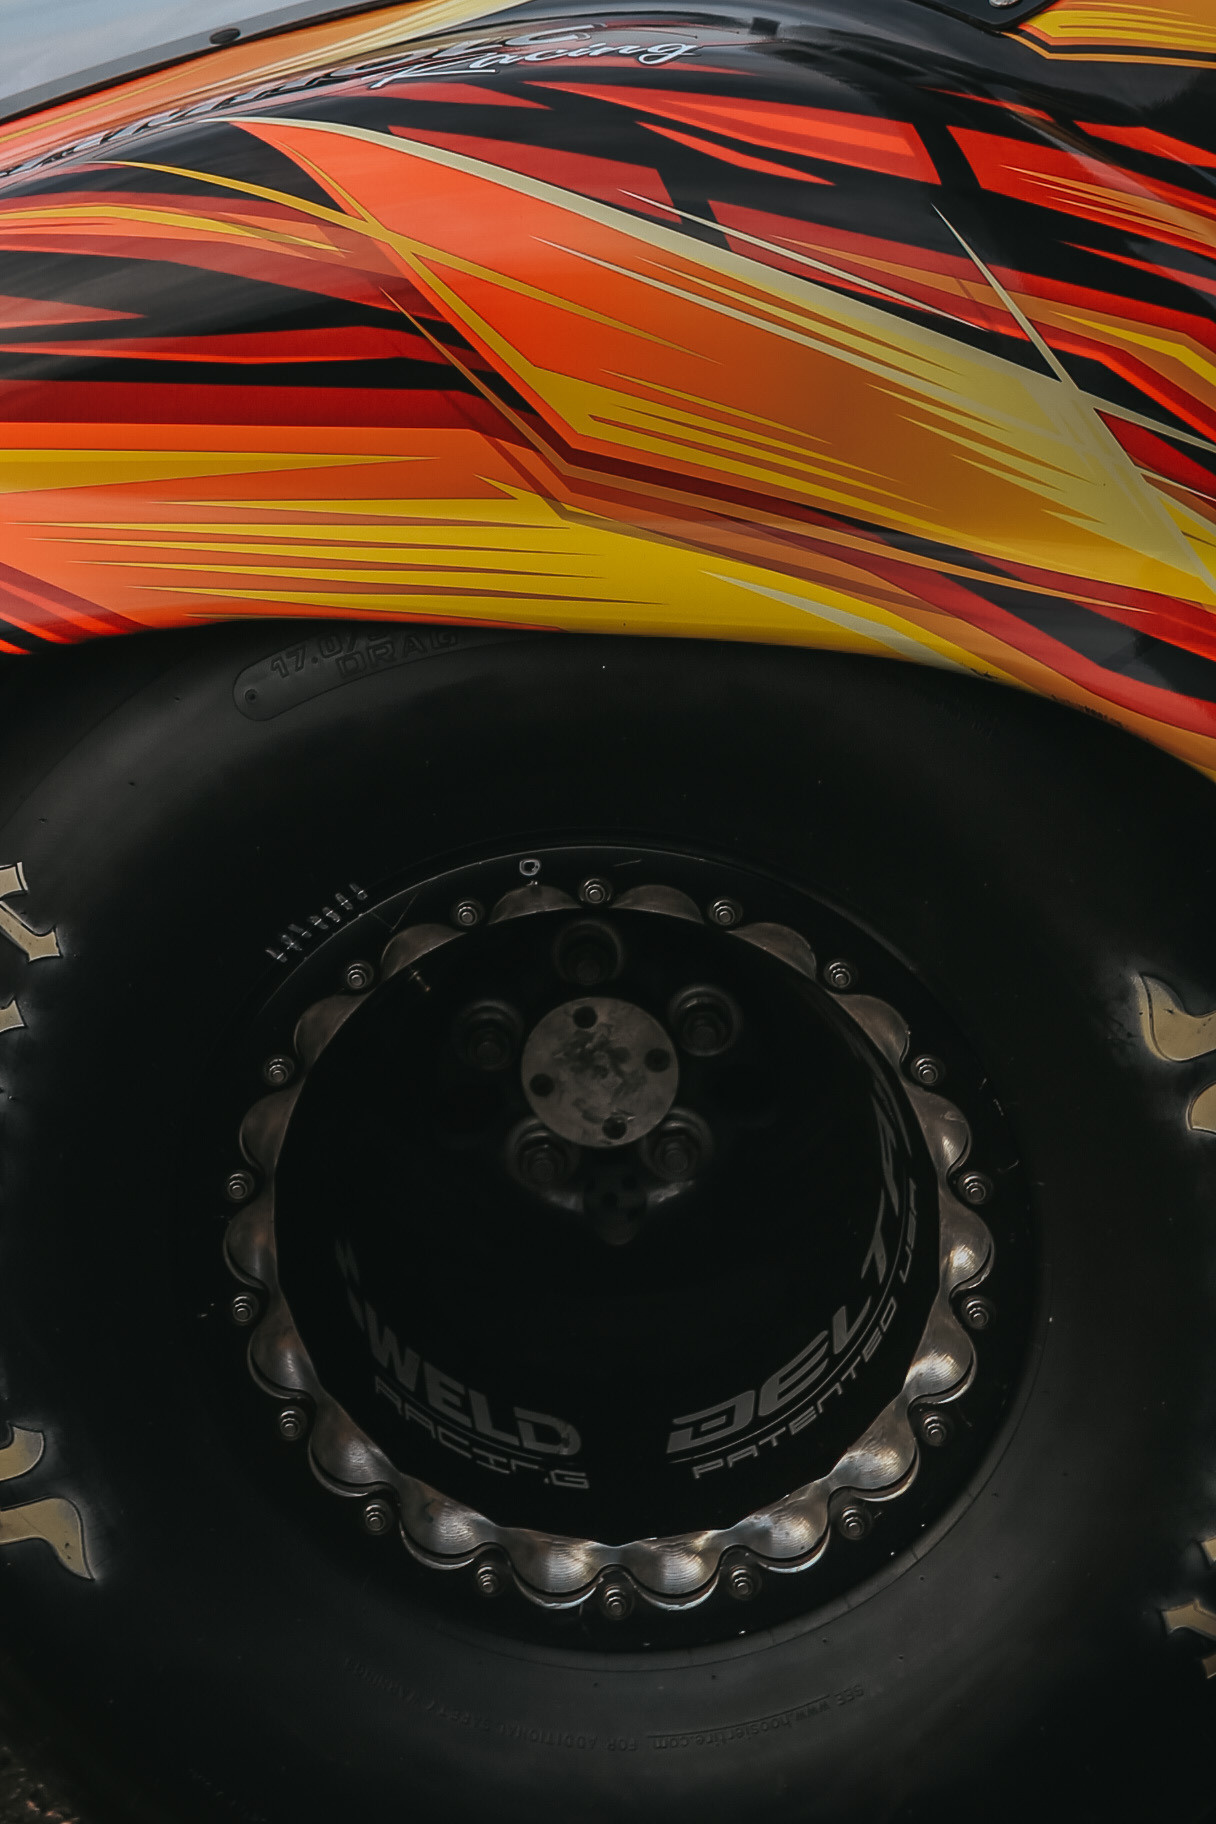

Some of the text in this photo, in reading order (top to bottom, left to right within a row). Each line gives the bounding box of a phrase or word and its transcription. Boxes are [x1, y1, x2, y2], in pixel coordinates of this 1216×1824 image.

[364, 38, 700, 90] Racing
[365, 1298, 581, 1457] WELD
[832, 1683, 866, 1707] SEE
[606, 1736, 638, 1753] FOR
[651, 1698, 831, 1752] www.hoosiertire.com
